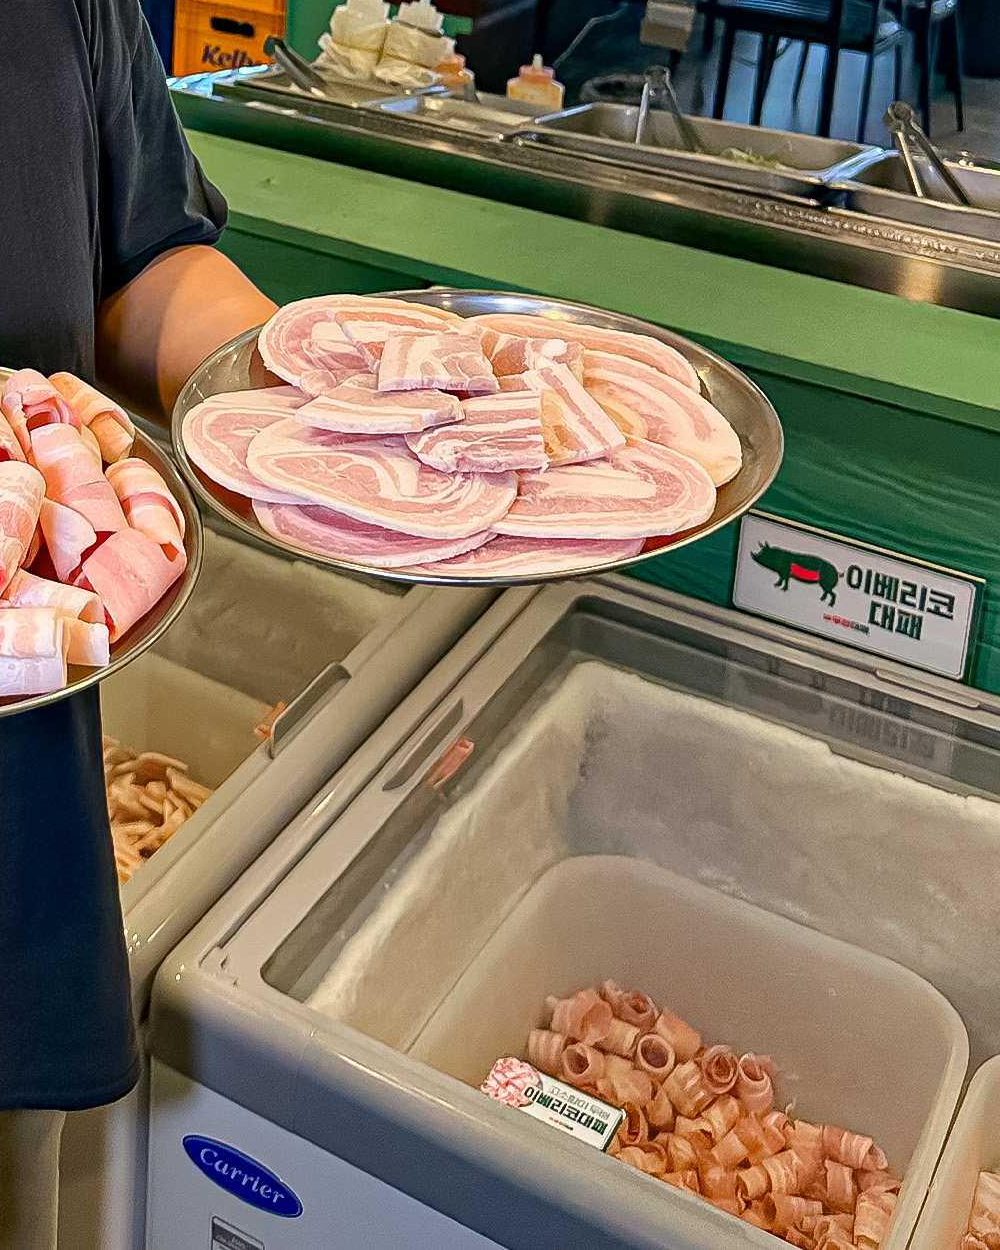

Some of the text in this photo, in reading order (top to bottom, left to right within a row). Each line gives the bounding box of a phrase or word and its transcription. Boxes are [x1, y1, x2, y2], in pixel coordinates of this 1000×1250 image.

[201, 43, 262, 69] Kell
[846, 564, 956, 620] 이베리코
[868, 600, 924, 641] 대패
[524, 1086, 608, 1136] 이베리코대패
[200, 1148, 285, 1203] Carrier
